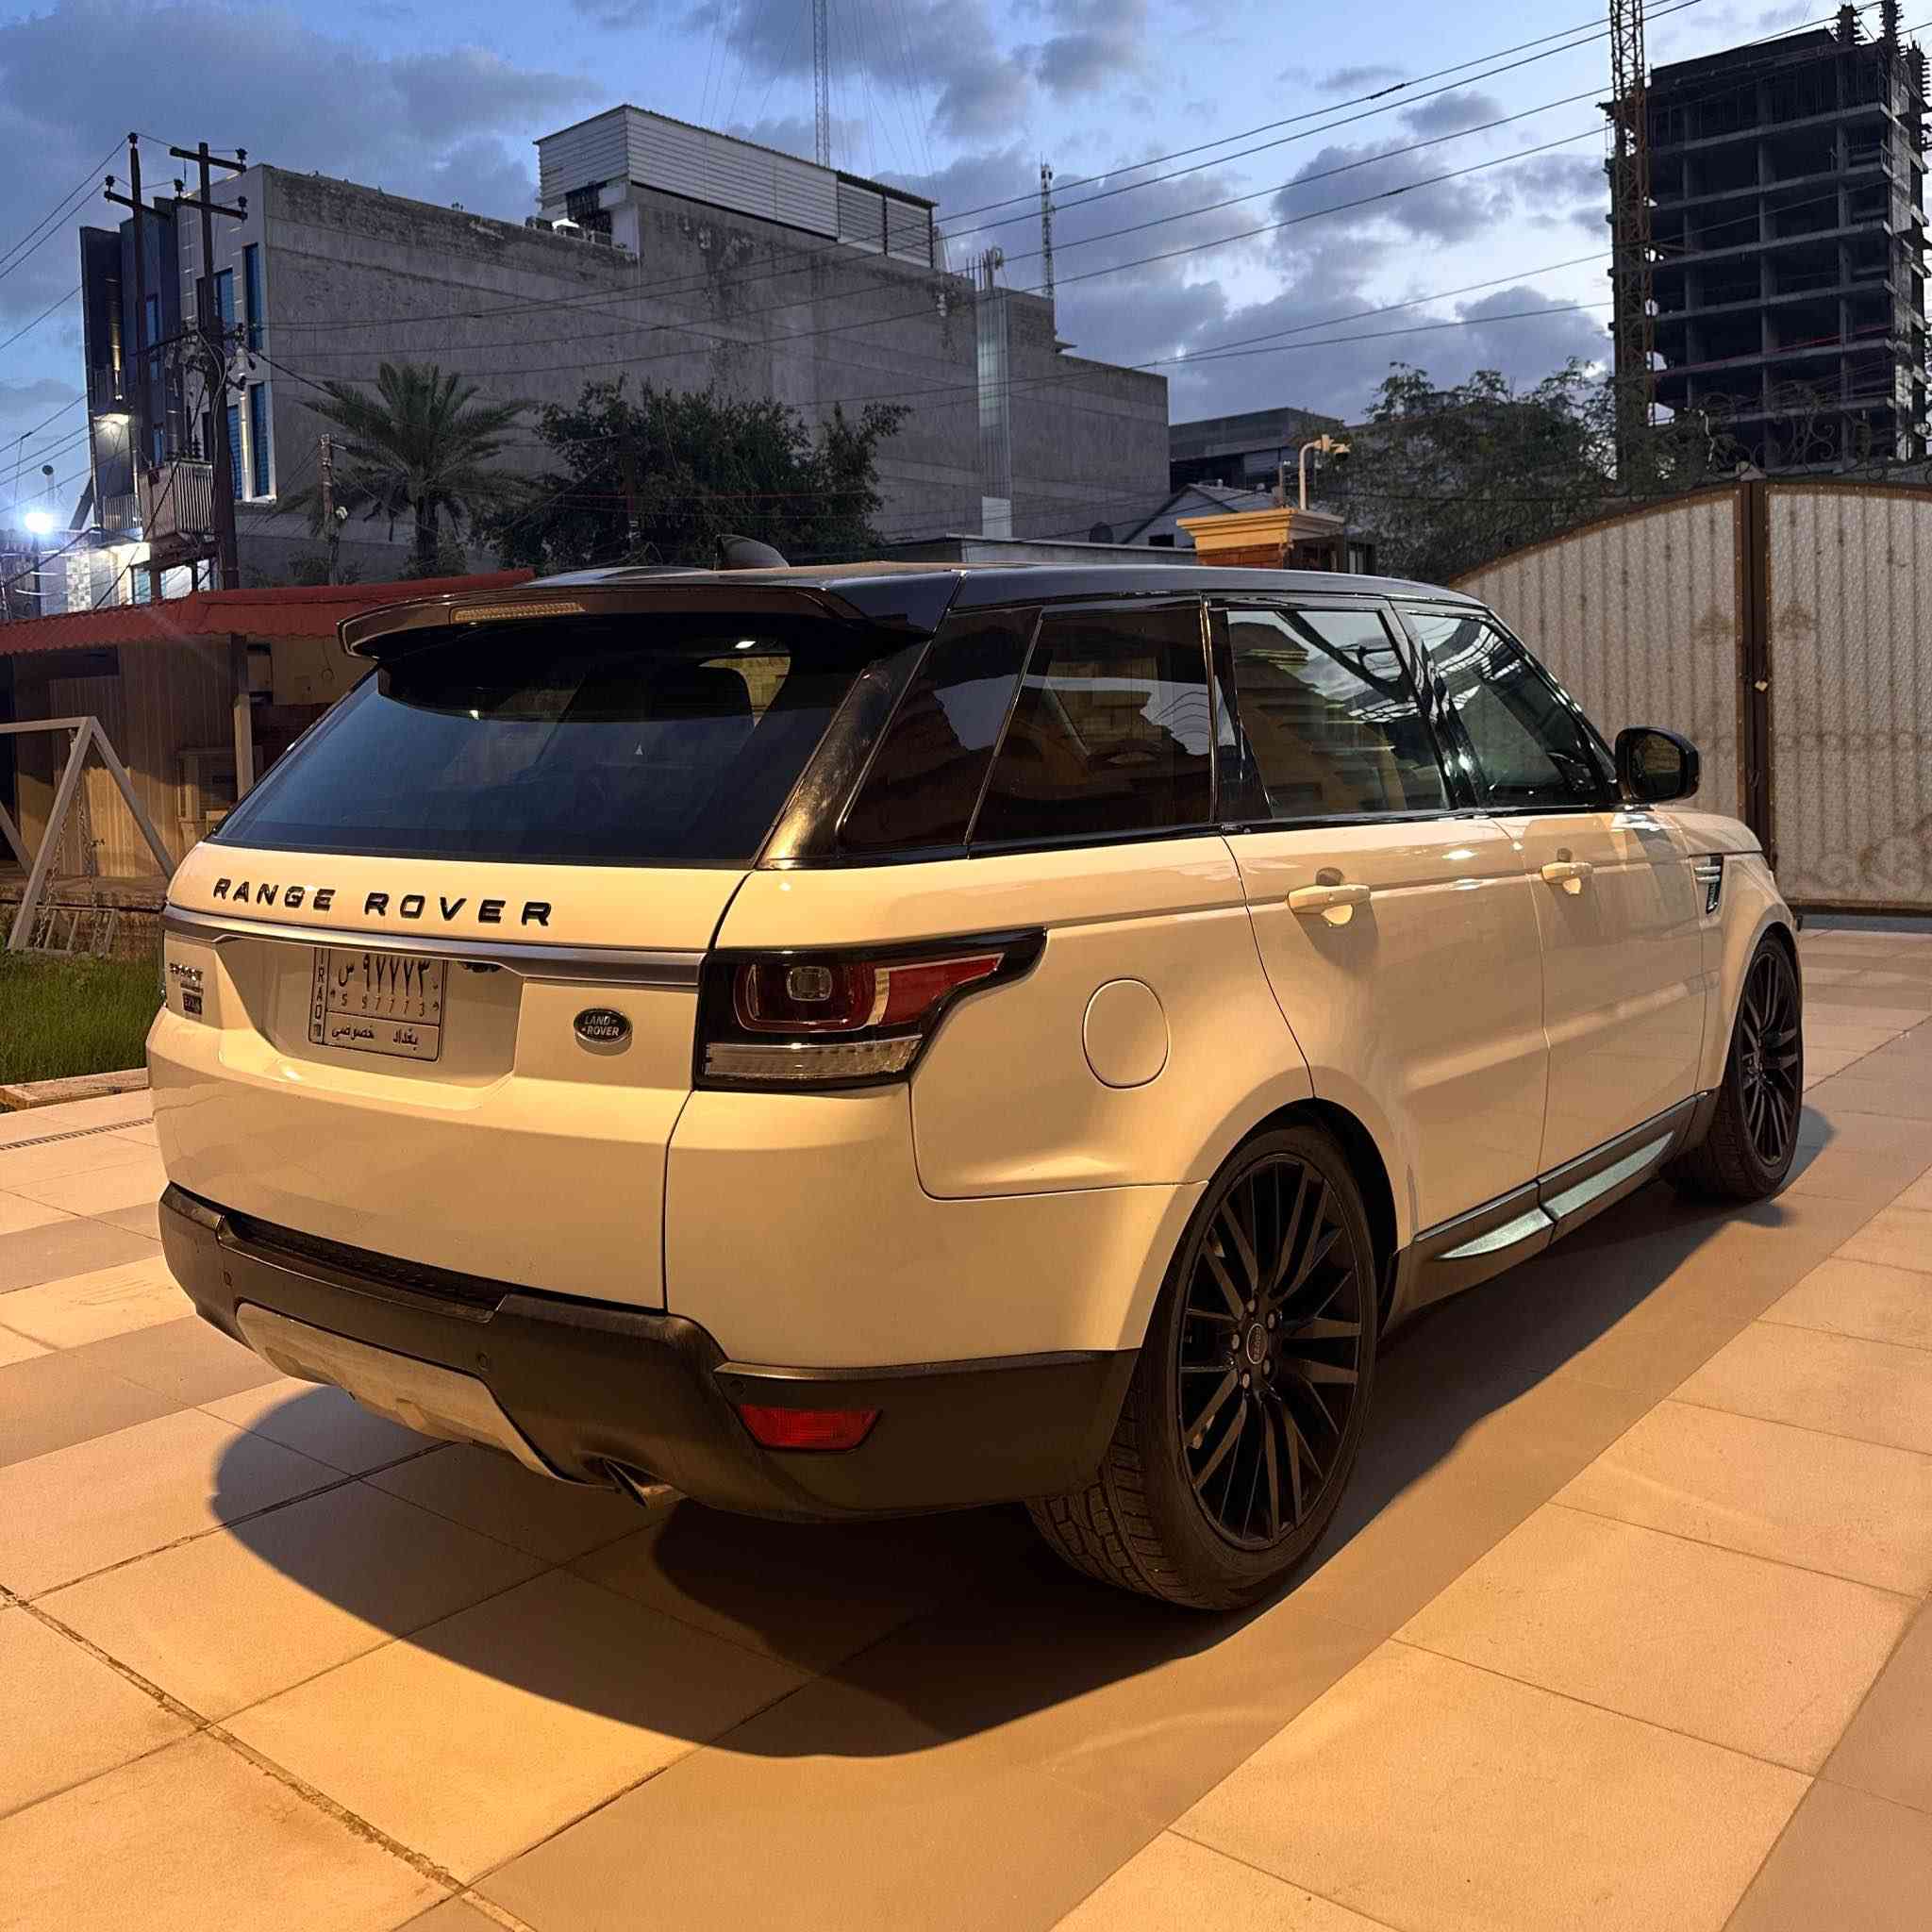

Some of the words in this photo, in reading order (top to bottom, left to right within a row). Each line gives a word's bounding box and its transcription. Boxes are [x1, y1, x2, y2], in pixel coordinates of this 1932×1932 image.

[212, 877, 336, 912] RANGE
[363, 891, 553, 926] ROVER
[585, 1015, 611, 1026] LAND
[587, 1025, 620, 1037] ROVER
